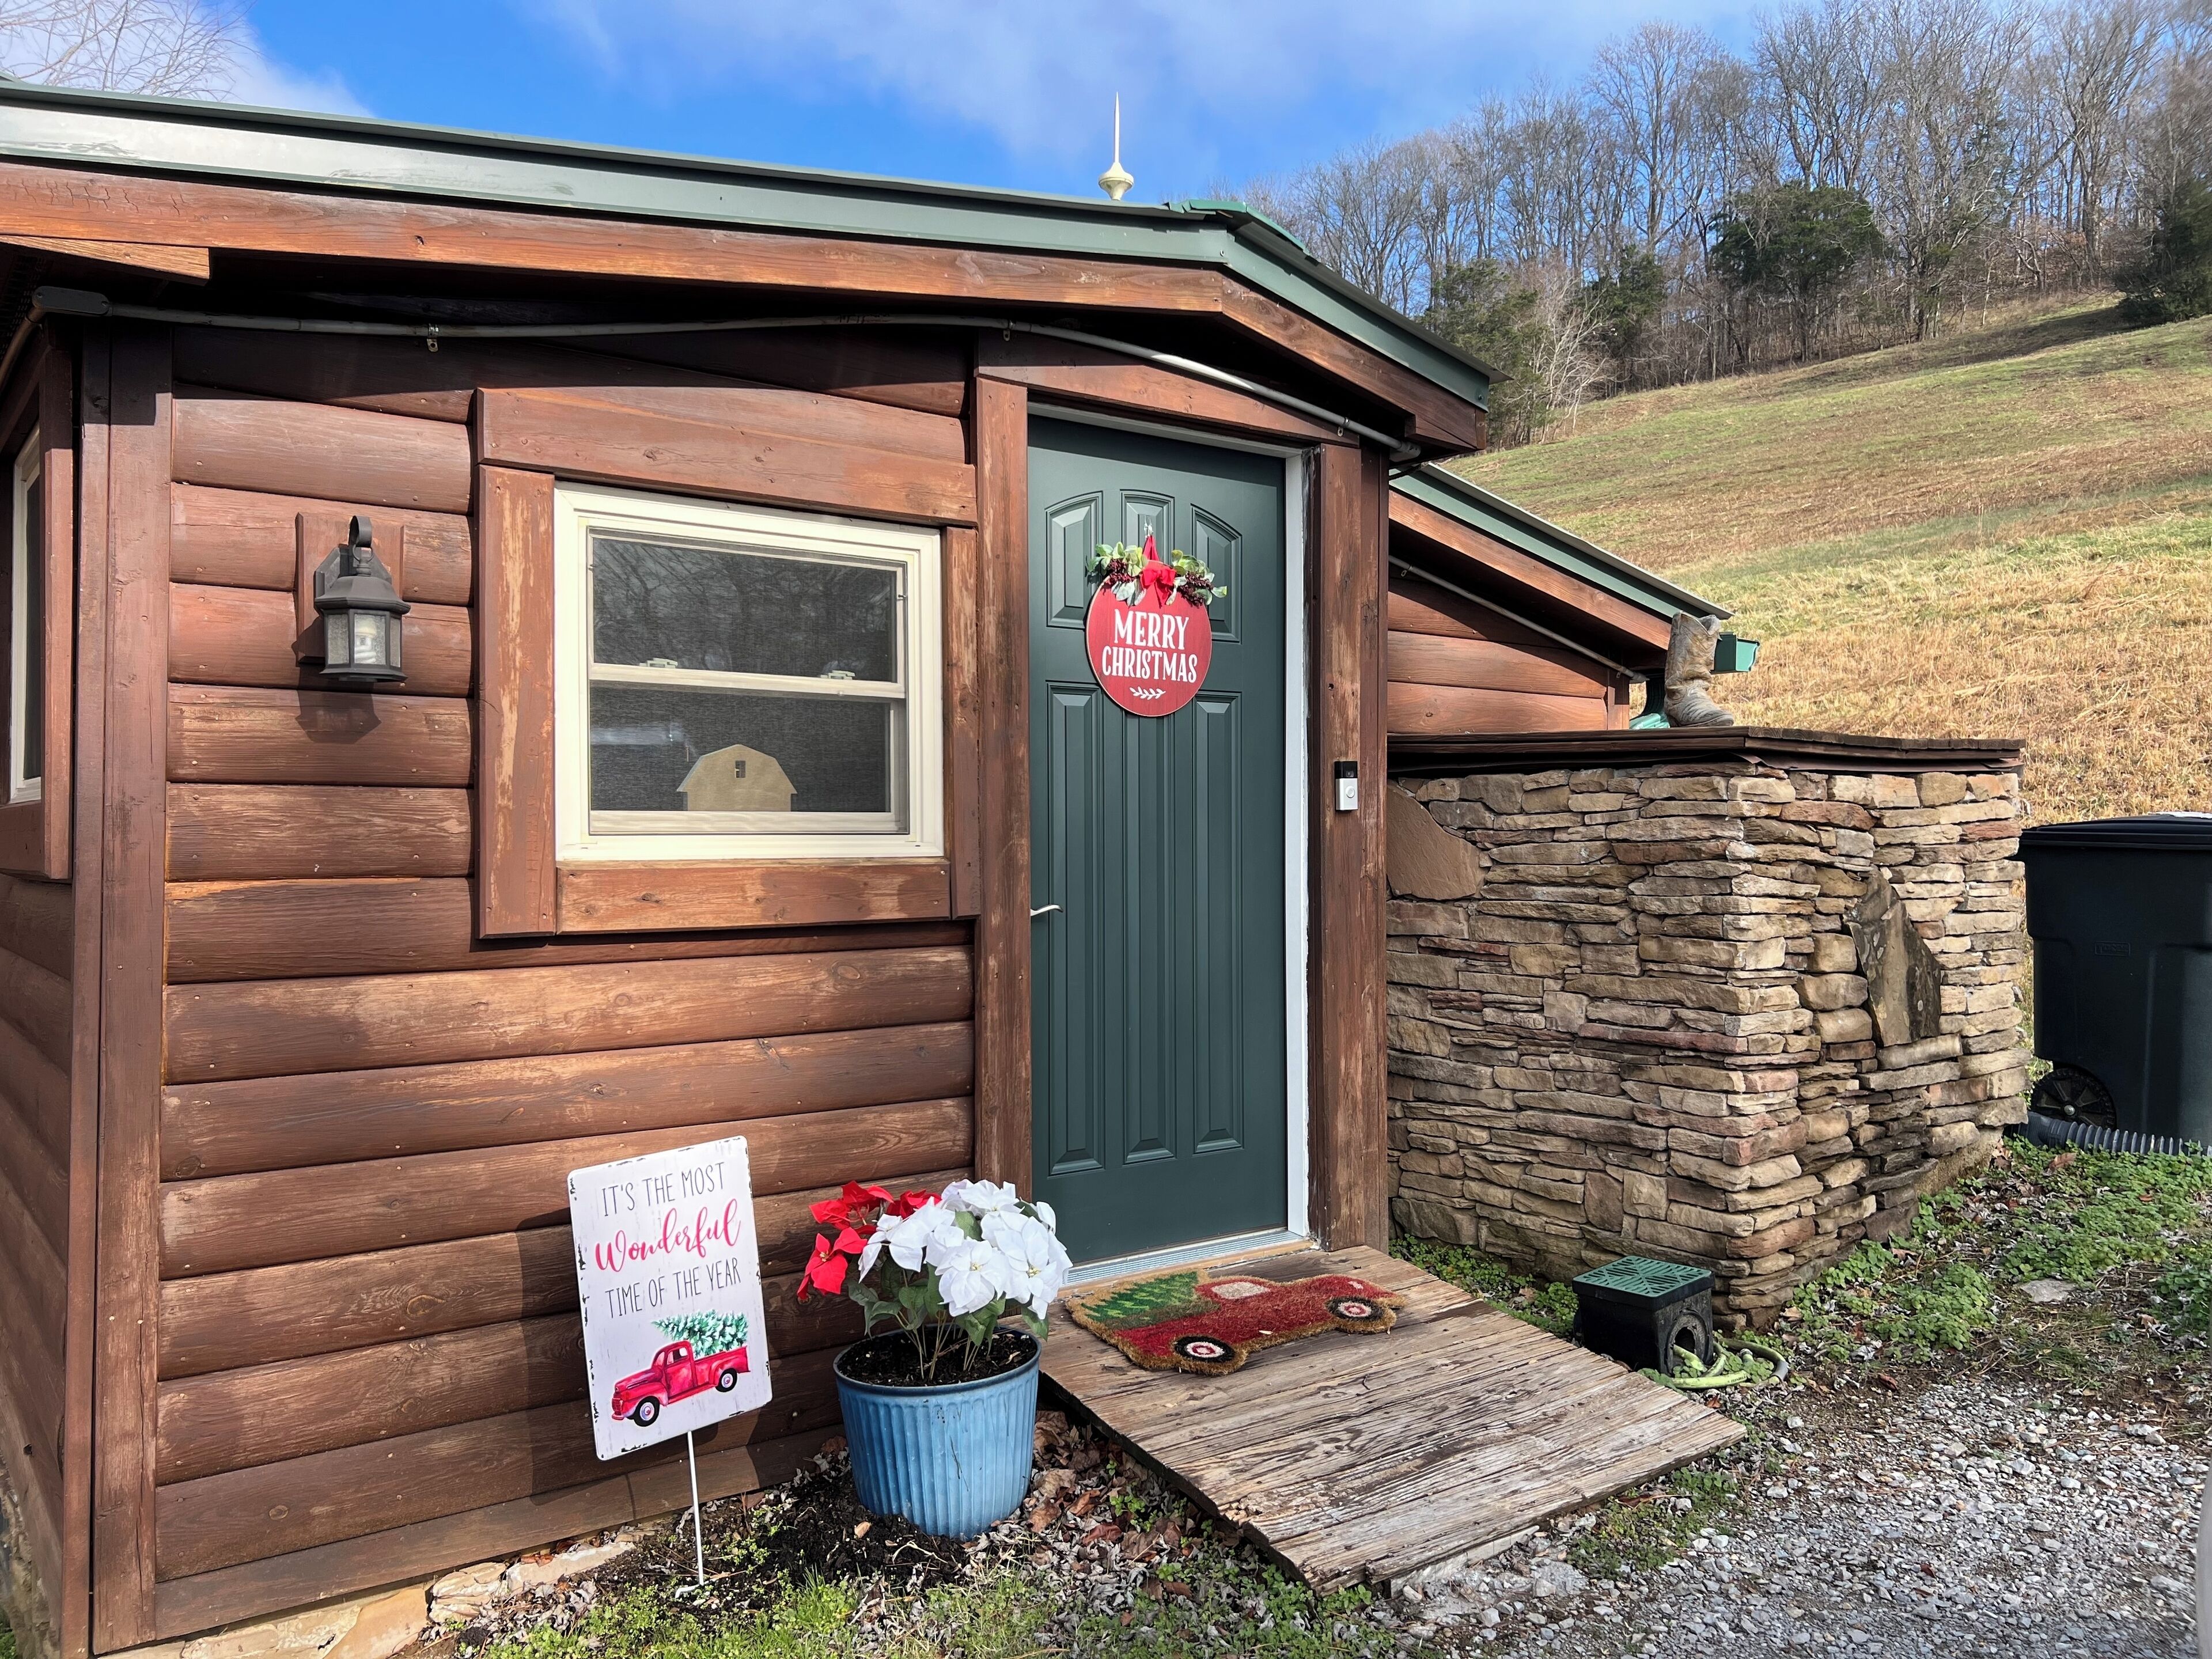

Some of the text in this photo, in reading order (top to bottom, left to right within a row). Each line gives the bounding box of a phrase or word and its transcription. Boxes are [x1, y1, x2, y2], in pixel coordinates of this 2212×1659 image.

[1114, 609, 1190, 650] MERRY
[1101, 646, 1198, 683] CHRISTMAS
[602, 1162, 725, 1217] IT'S THE MOST
[595, 1199, 741, 1272] Wonderful
[605, 1257, 741, 1319] TIME OF THE YEAR
